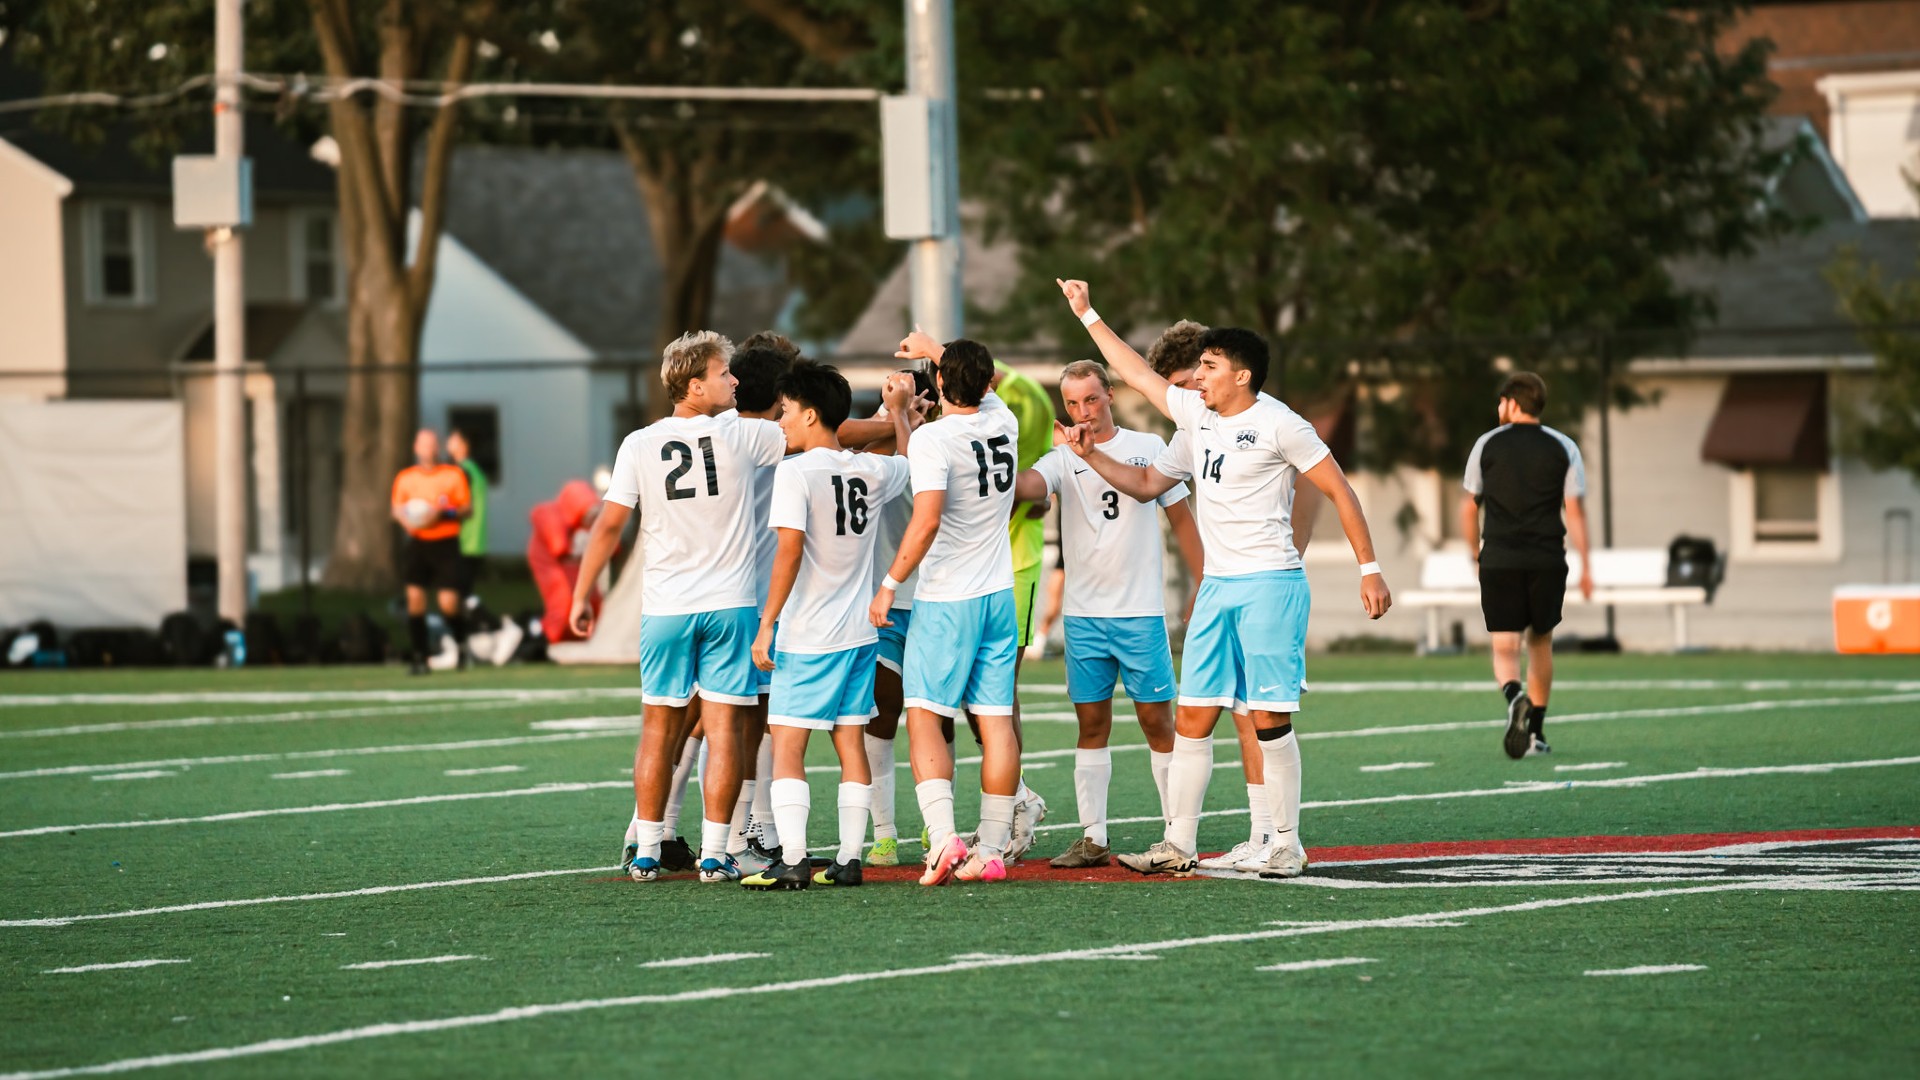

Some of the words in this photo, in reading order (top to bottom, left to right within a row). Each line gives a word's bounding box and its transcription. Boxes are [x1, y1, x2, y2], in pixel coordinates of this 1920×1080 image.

[1237, 434, 1256, 444] SAU
[660, 436, 719, 501] 21
[970, 434, 1014, 498] 15
[1202, 448, 1225, 484] 14
[831, 475, 869, 536] 16
[1102, 490, 1120, 520] 3
